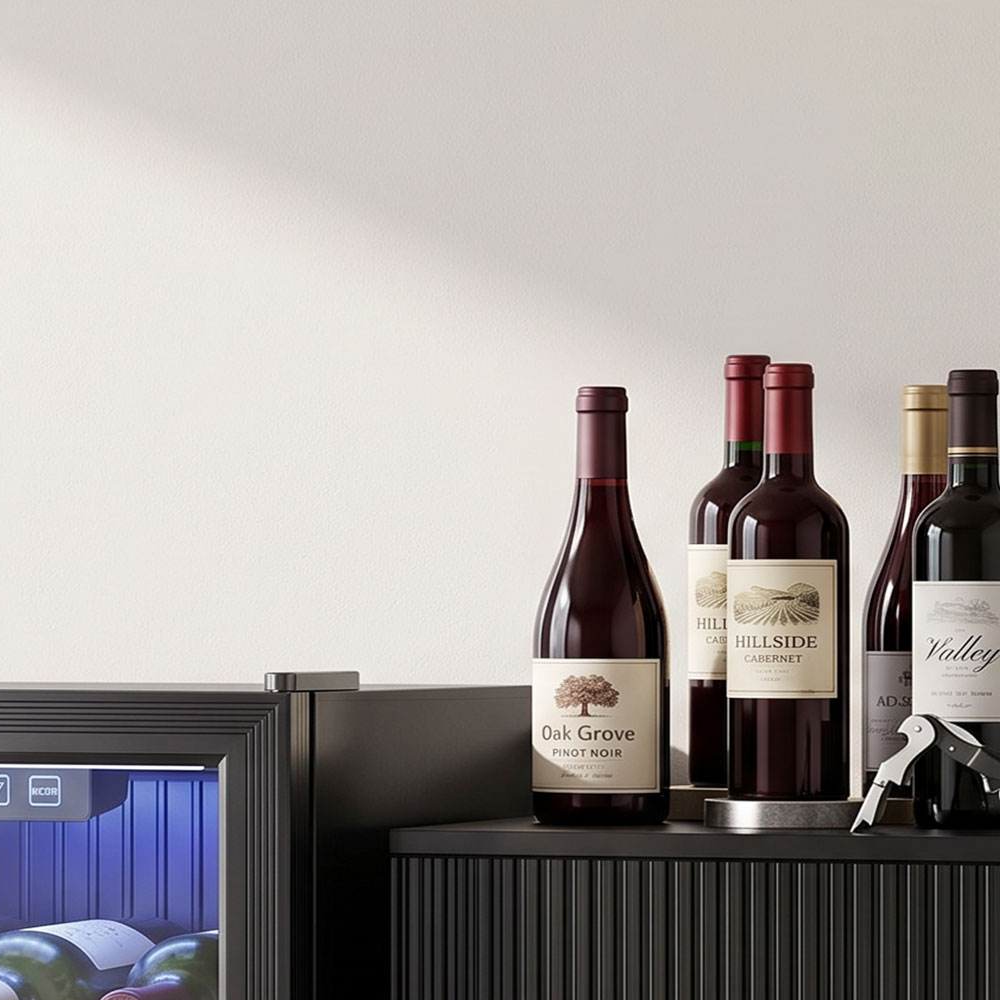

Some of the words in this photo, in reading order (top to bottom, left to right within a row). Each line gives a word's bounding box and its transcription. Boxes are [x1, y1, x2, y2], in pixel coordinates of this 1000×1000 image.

[735, 635, 818, 649] HILLSIDE
[744, 654, 803, 664] CABERNET
[925, 634, 1000, 673] Valley
[541, 724, 572, 741] Oak
[577, 725, 636, 742] Grove
[552, 748, 587, 758] PINOT
[590, 748, 623, 758] NOIR
